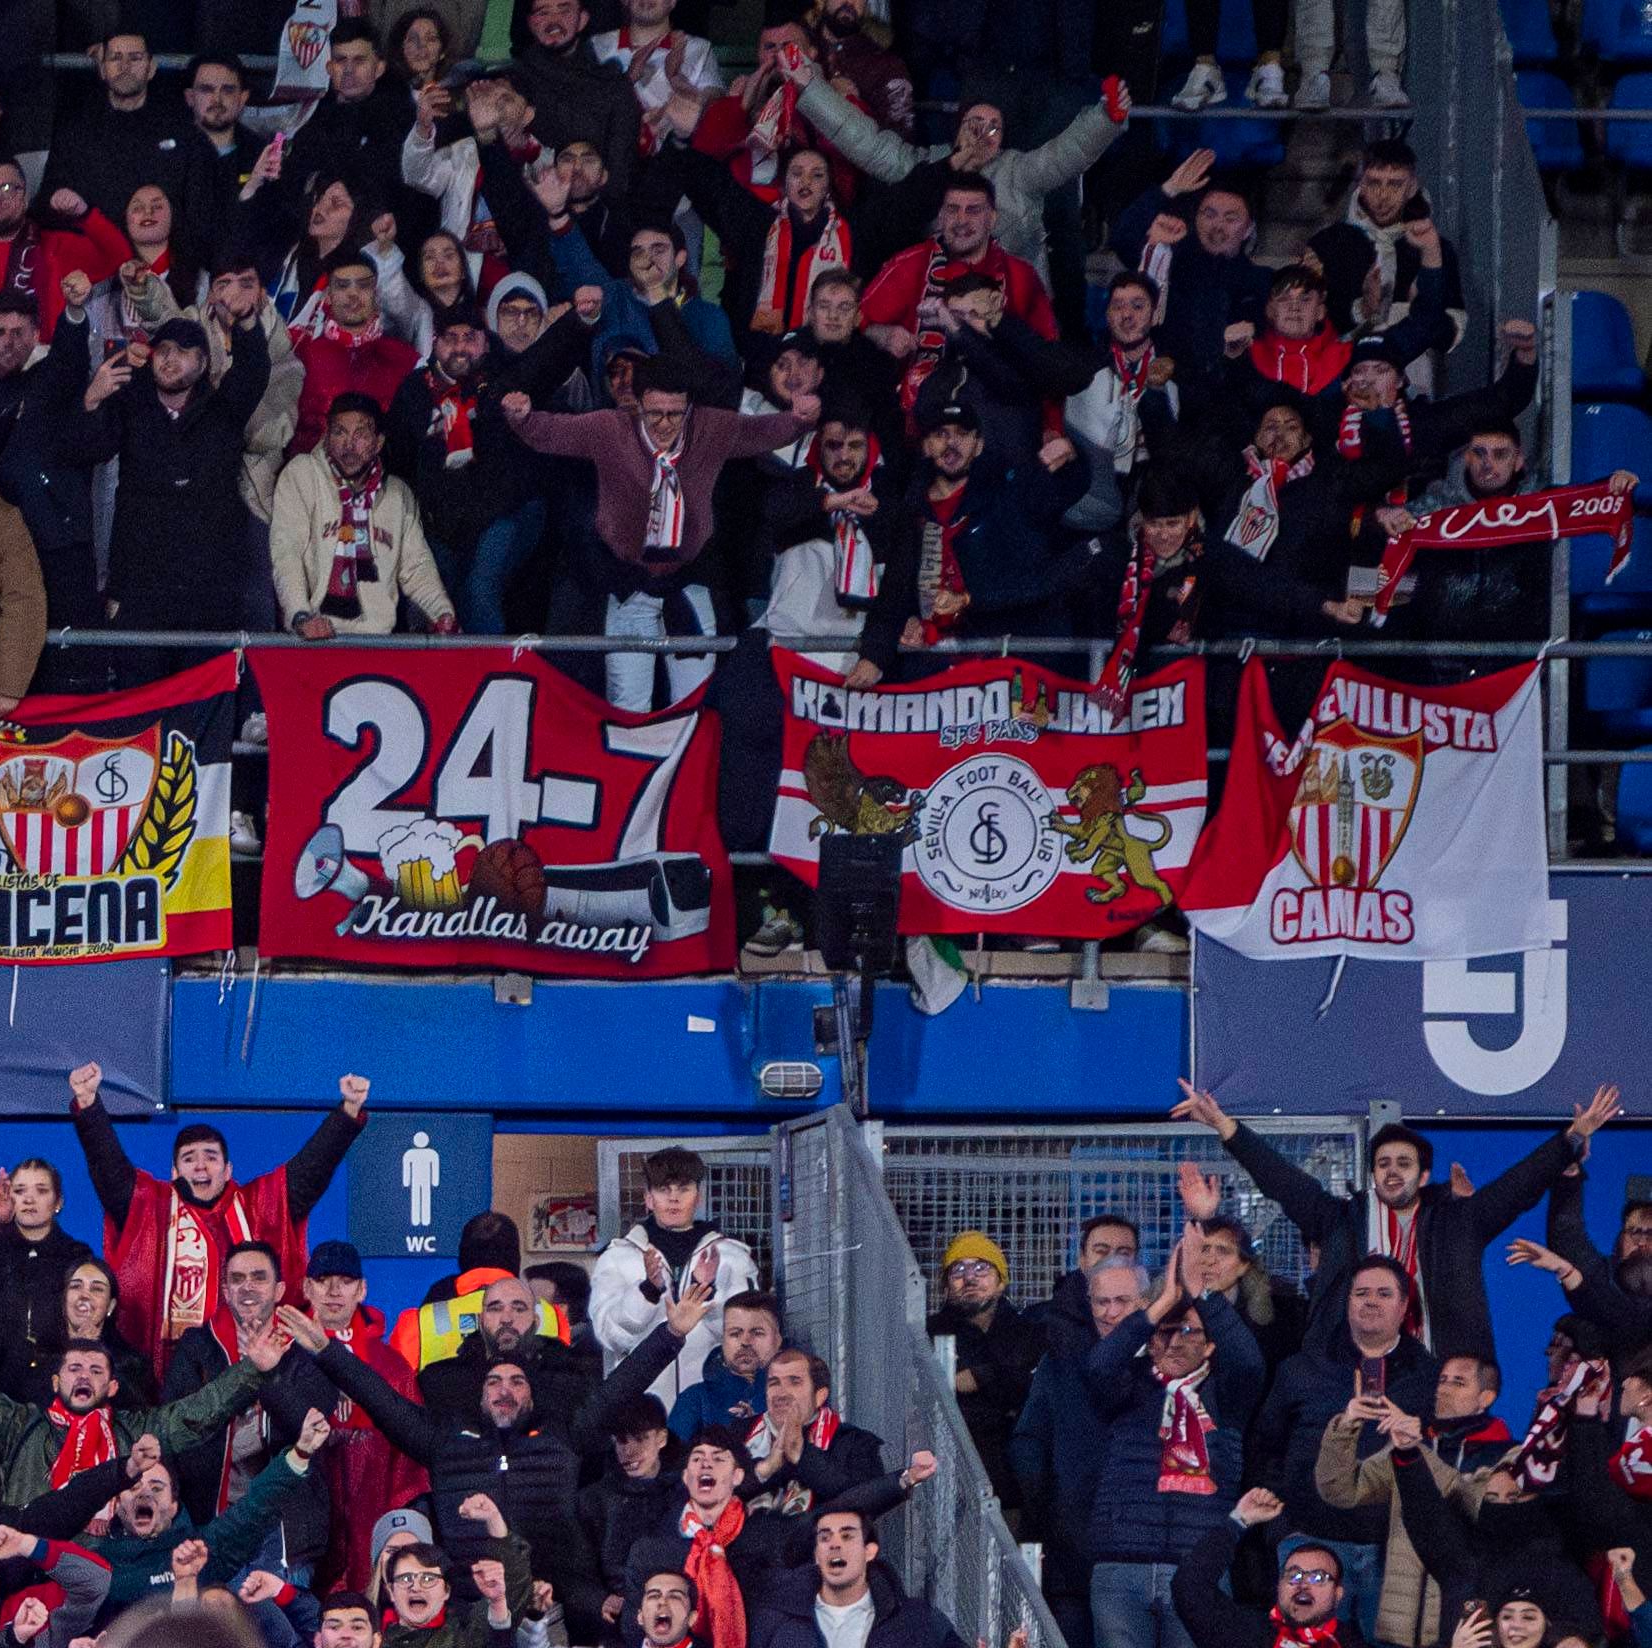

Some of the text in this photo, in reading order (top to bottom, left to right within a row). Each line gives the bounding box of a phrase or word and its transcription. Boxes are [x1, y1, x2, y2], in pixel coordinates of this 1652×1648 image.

[1316, 677, 1497, 752] EVILLISTA
[319, 672, 701, 862] 24-7
[954, 766, 999, 793] FOOT
[1006, 769, 1044, 804] BALL
[351, 894, 653, 964] Kanallas away
[1269, 887, 1414, 946] CAMAS
[406, 1236, 436, 1252] WC
